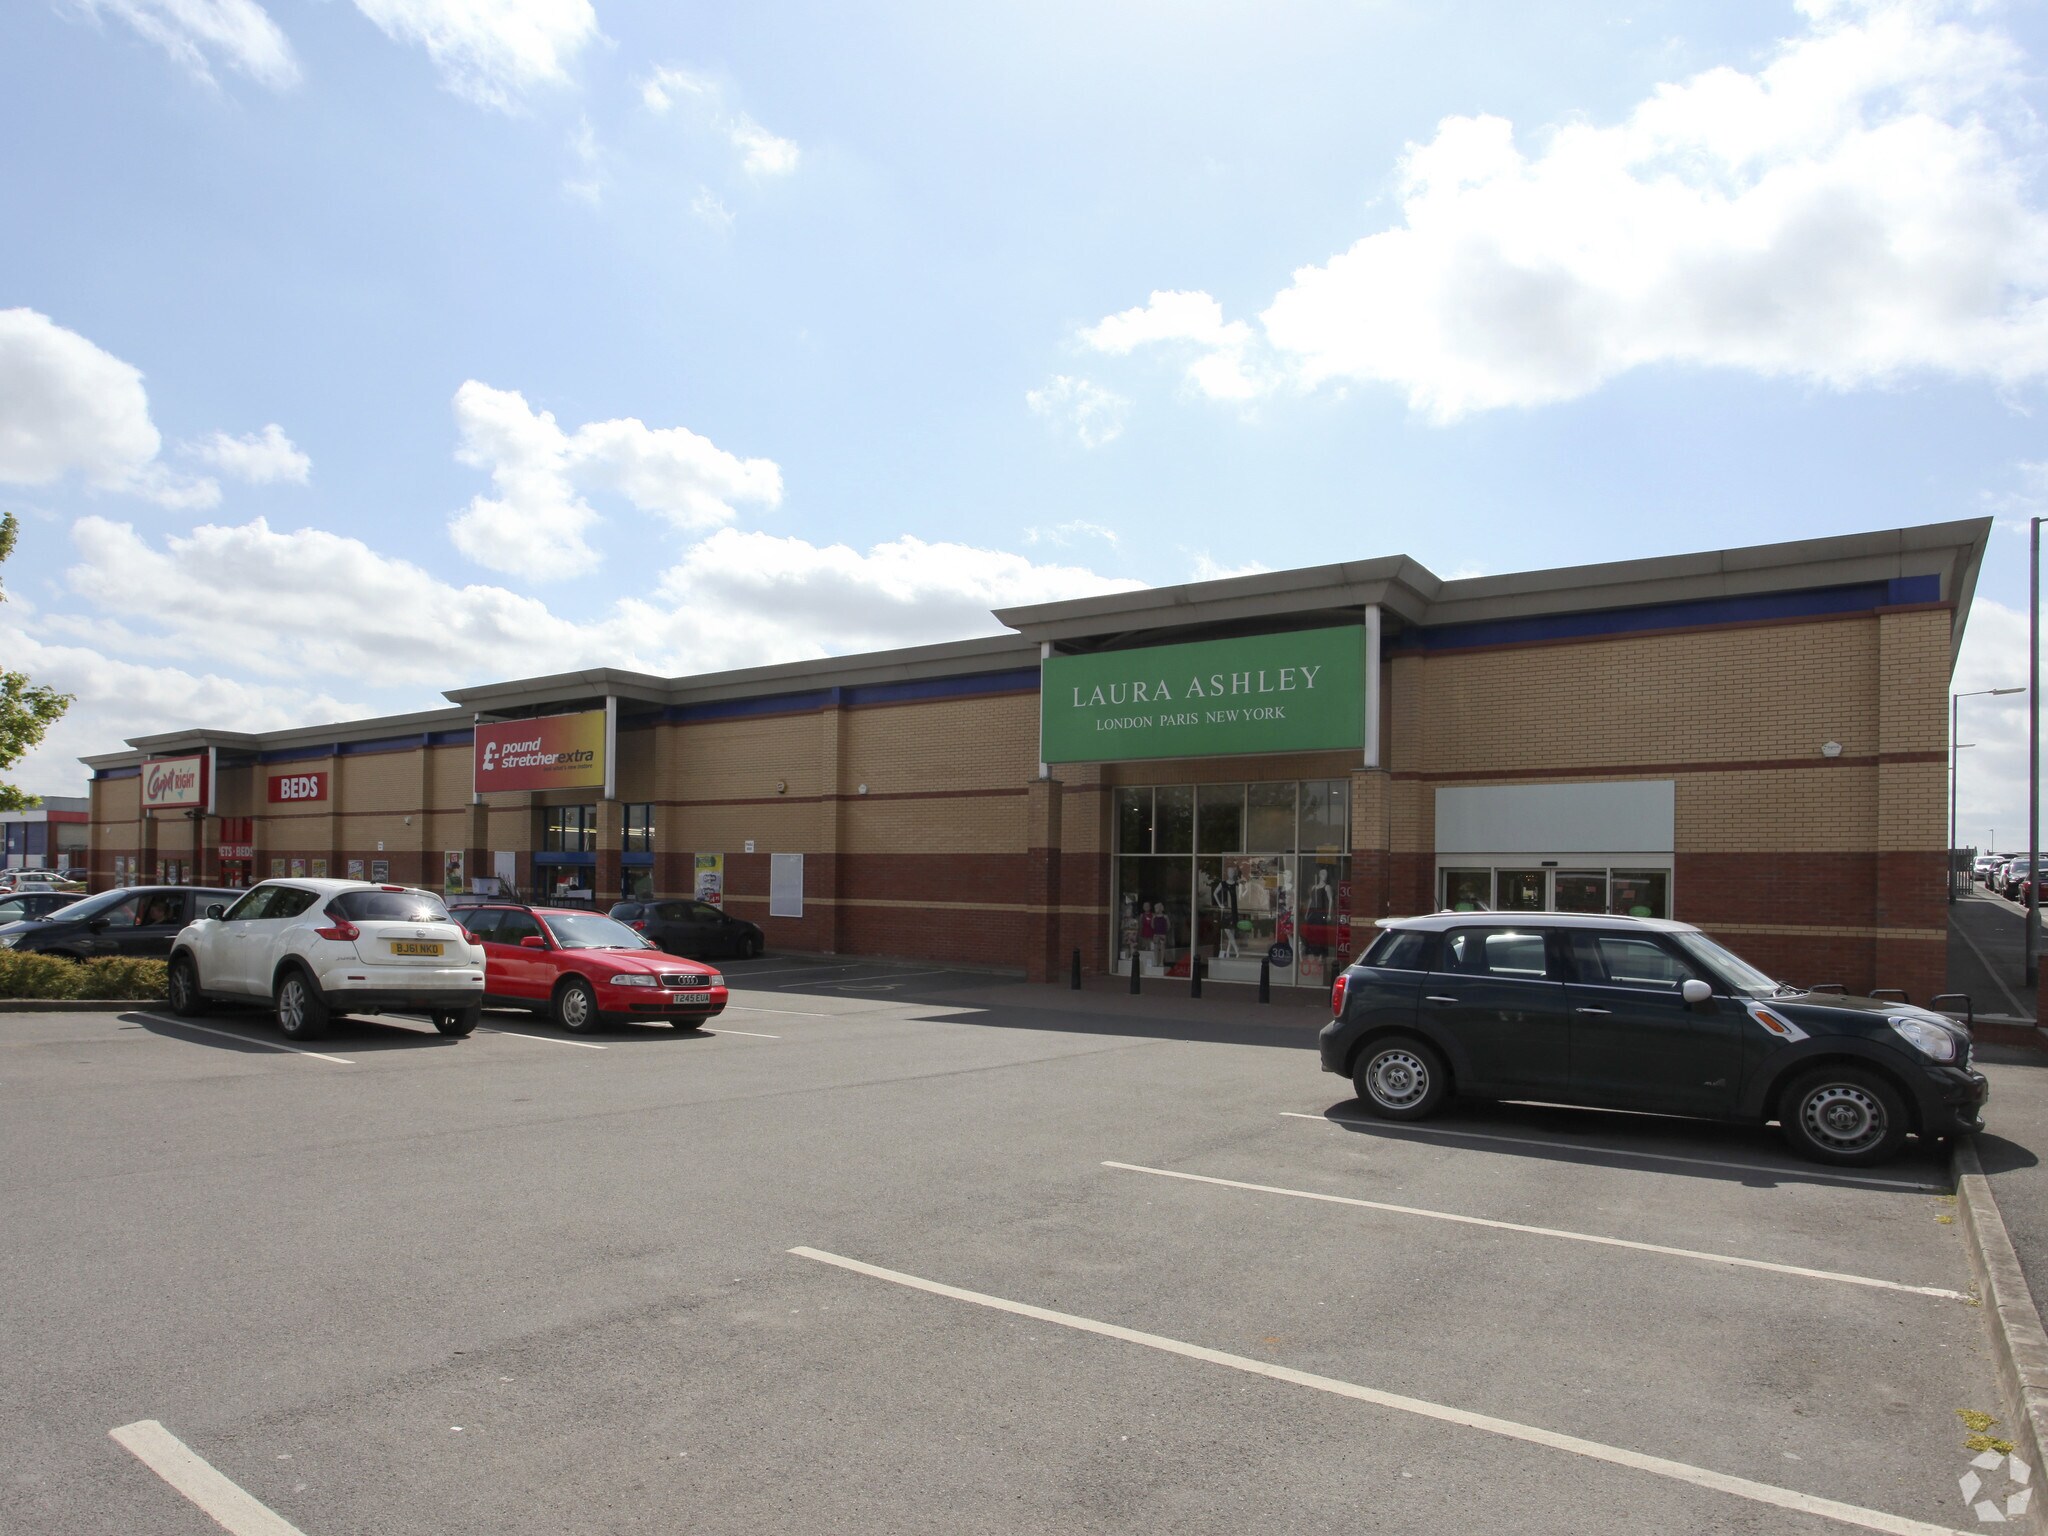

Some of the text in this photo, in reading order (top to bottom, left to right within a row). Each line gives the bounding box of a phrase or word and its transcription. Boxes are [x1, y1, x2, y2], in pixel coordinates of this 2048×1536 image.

[1072, 665, 1322, 707] LAURA ASHLEY
[1096, 707, 1286, 730] LONDON PARIS NEW YORK
[501, 737, 541, 757] pound
[281, 776, 318, 799] BEDS
[397, 943, 418, 953] BJ61
[674, 994, 694, 1002] T245
